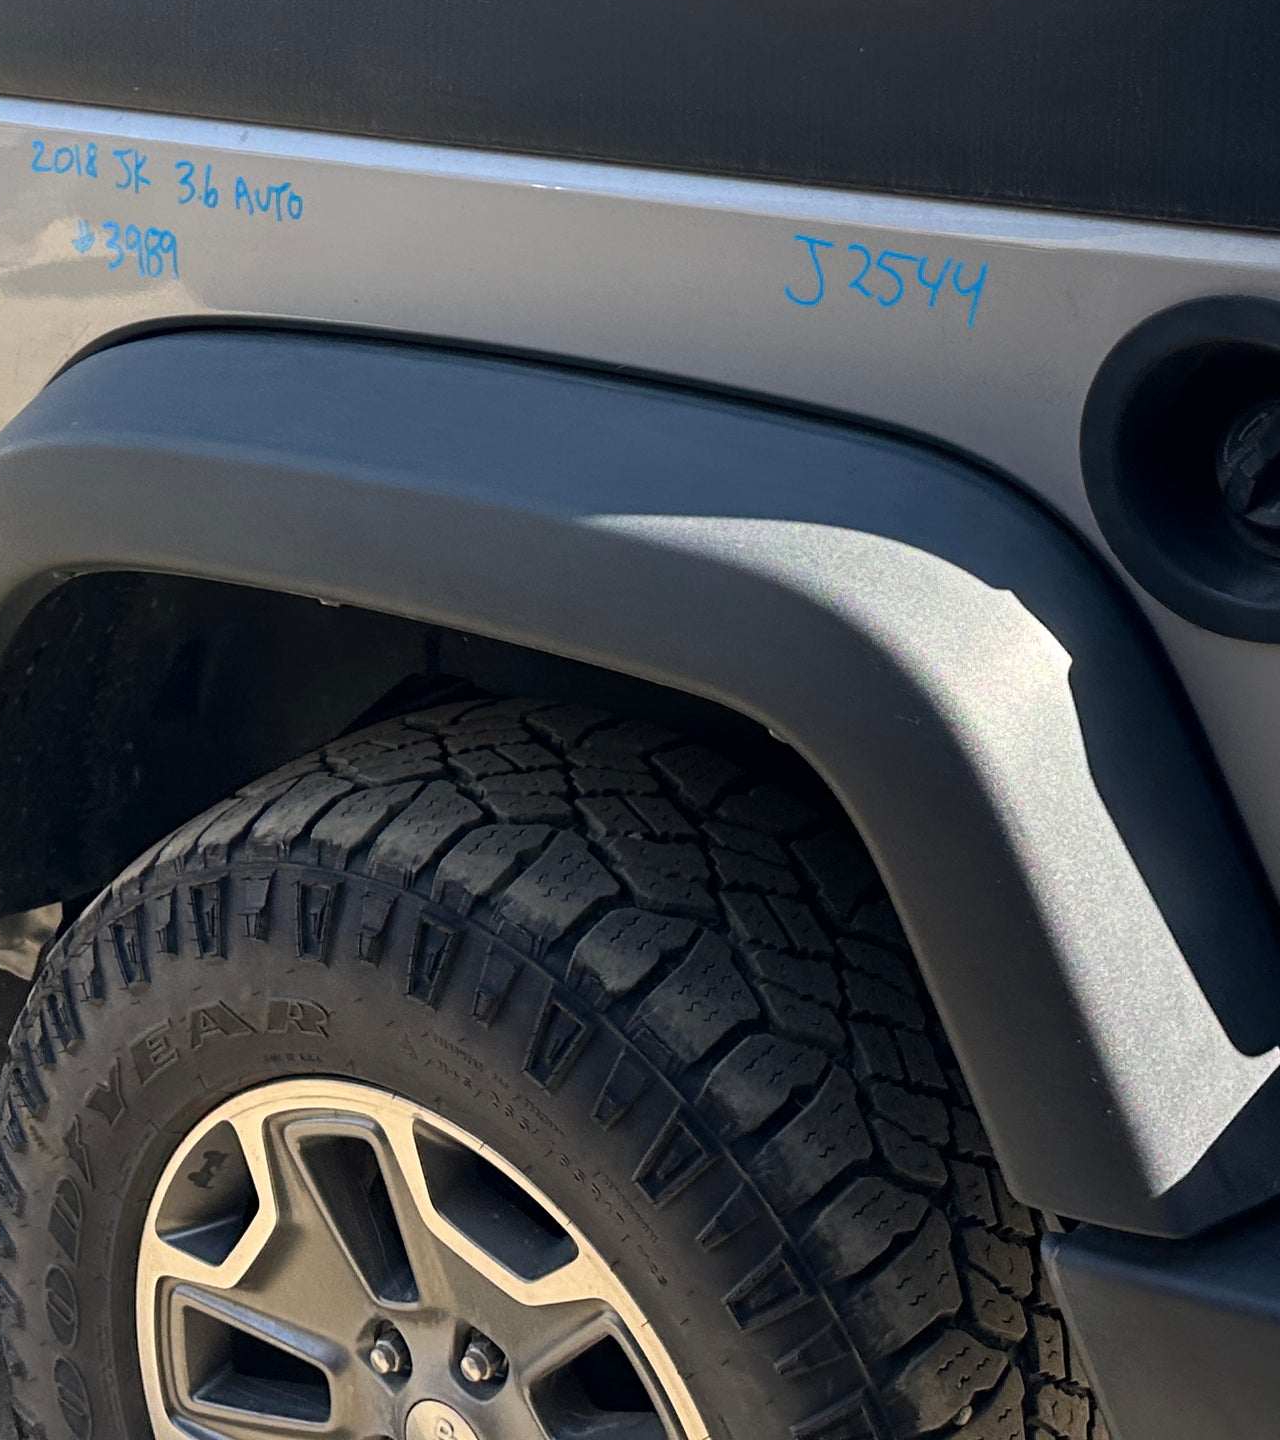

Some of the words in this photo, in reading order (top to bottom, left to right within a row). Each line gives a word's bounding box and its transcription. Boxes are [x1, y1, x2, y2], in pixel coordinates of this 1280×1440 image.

[31, 140, 98, 179] 2018
[112, 148, 151, 194] JK
[174, 161, 219, 208] 3.6
[235, 176, 303, 221] AUTO
[784, 234, 989, 328] J2544
